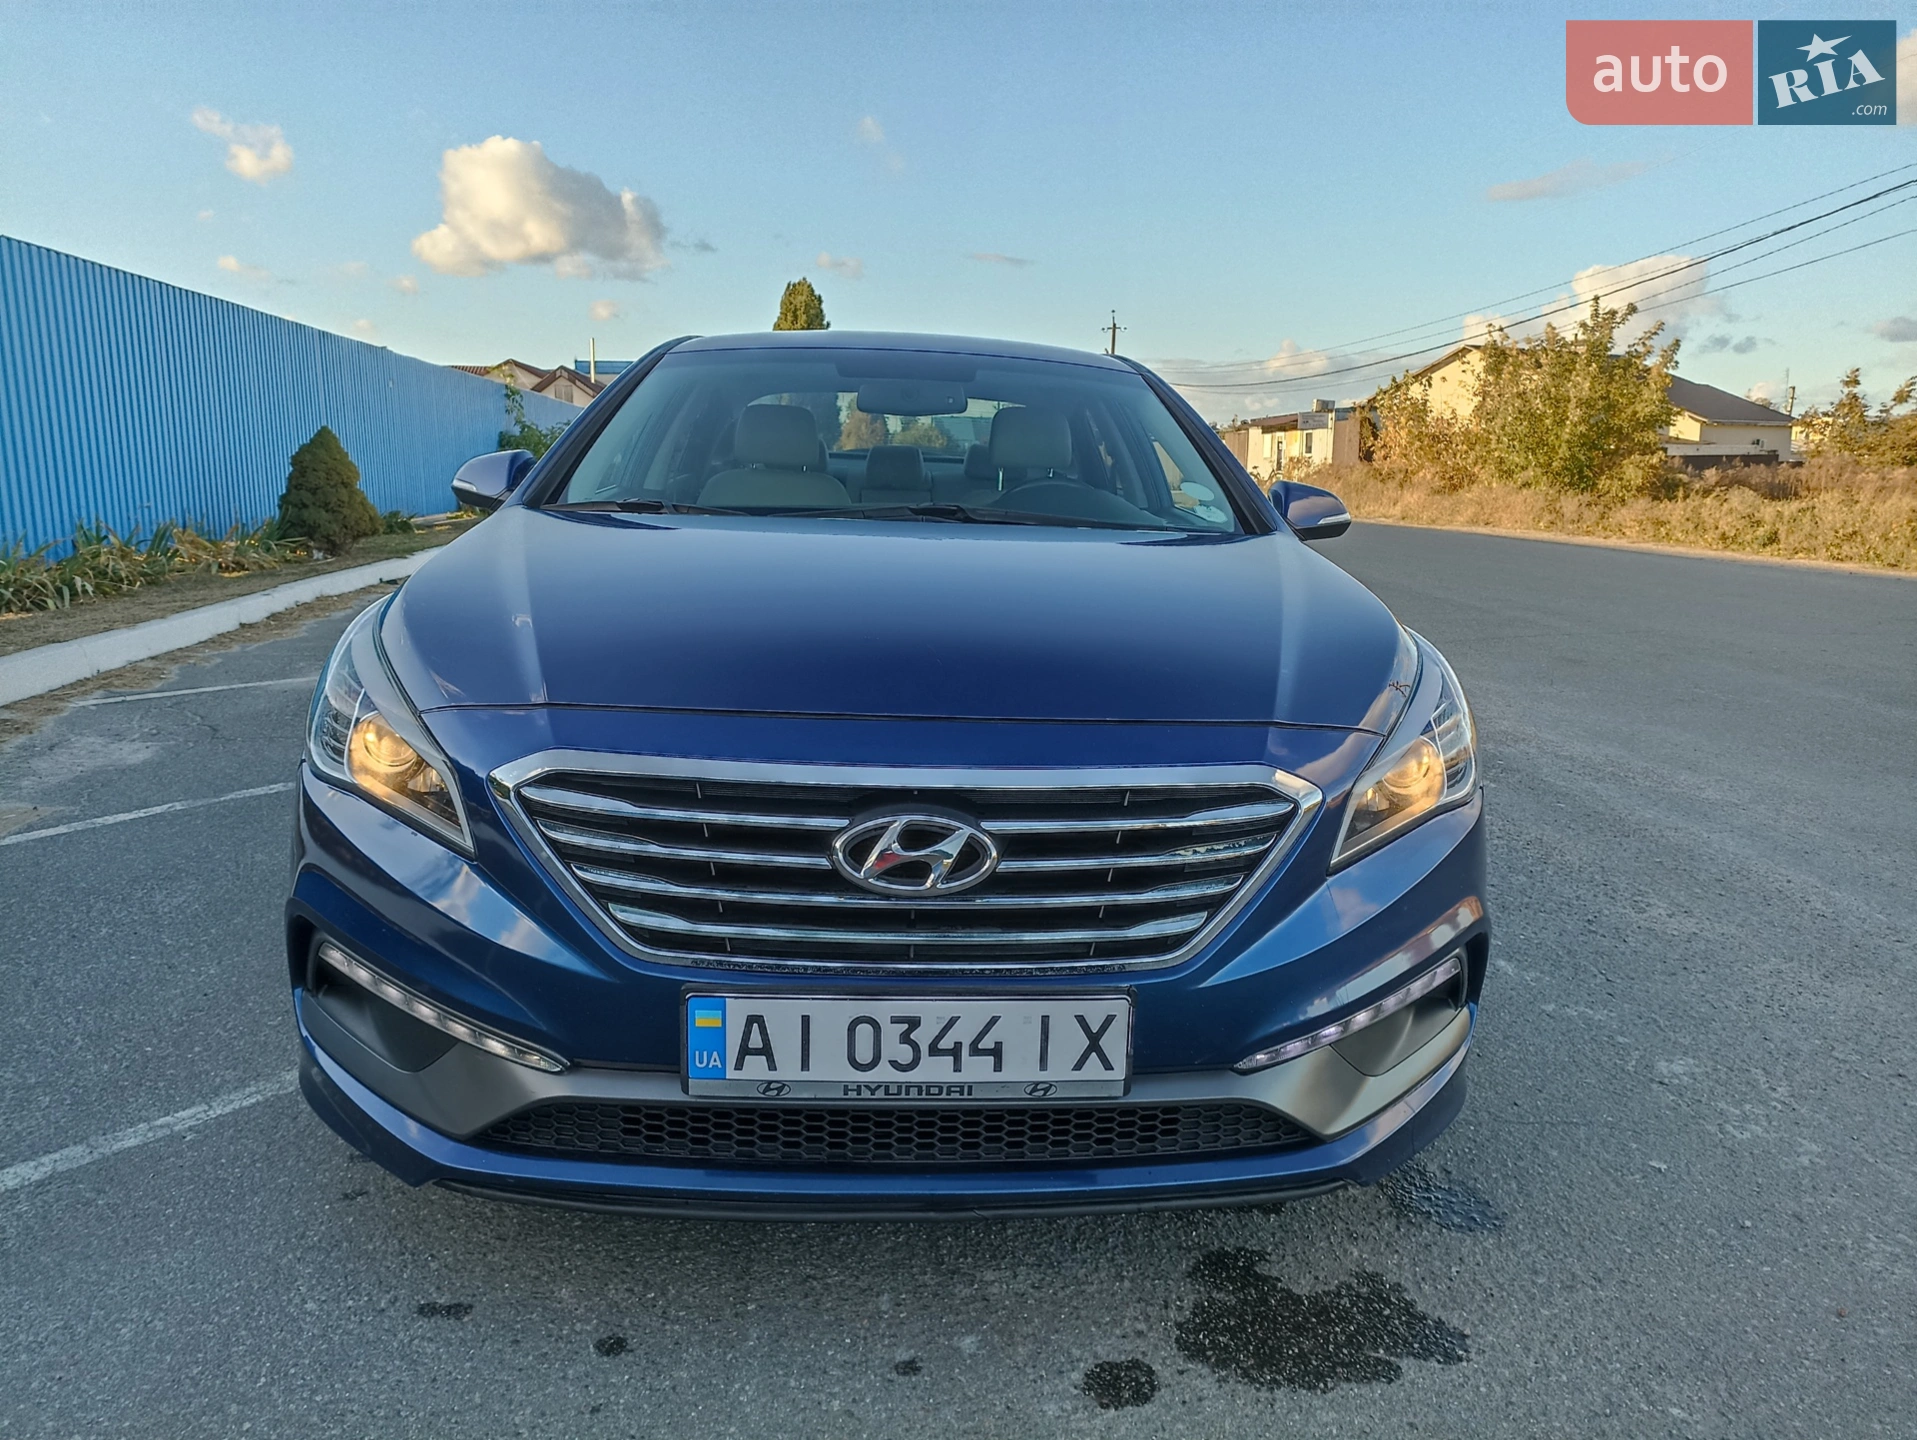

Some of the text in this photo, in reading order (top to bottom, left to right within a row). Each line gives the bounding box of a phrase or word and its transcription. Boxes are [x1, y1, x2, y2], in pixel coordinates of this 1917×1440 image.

[733, 1014, 1118, 1073] AI 0344 IX
[694, 1050, 722, 1069] UA
[843, 1084, 973, 1096] HYUNDAI
